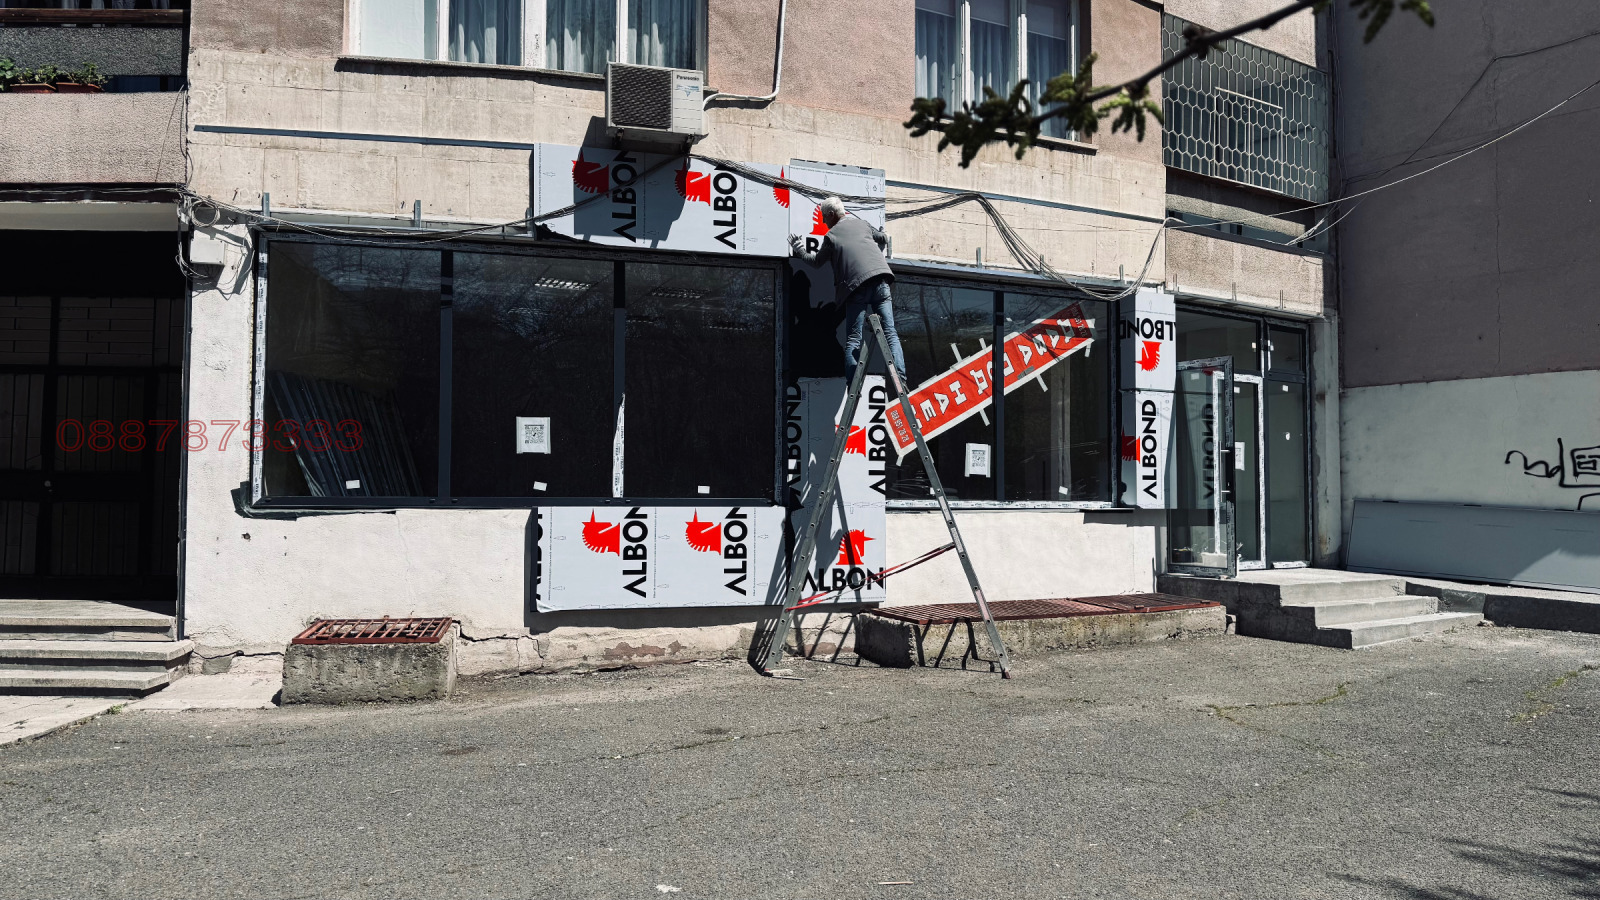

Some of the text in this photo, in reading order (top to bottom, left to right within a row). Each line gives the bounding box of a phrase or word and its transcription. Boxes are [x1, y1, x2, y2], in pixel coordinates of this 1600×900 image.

[1018, 318, 1076, 366] ДАВА
[1119, 317, 1177, 341] LBOND
[911, 380, 967, 430] НАЕ
[1142, 399, 1158, 499] ALBOND
[801, 566, 884, 592] ALBON
